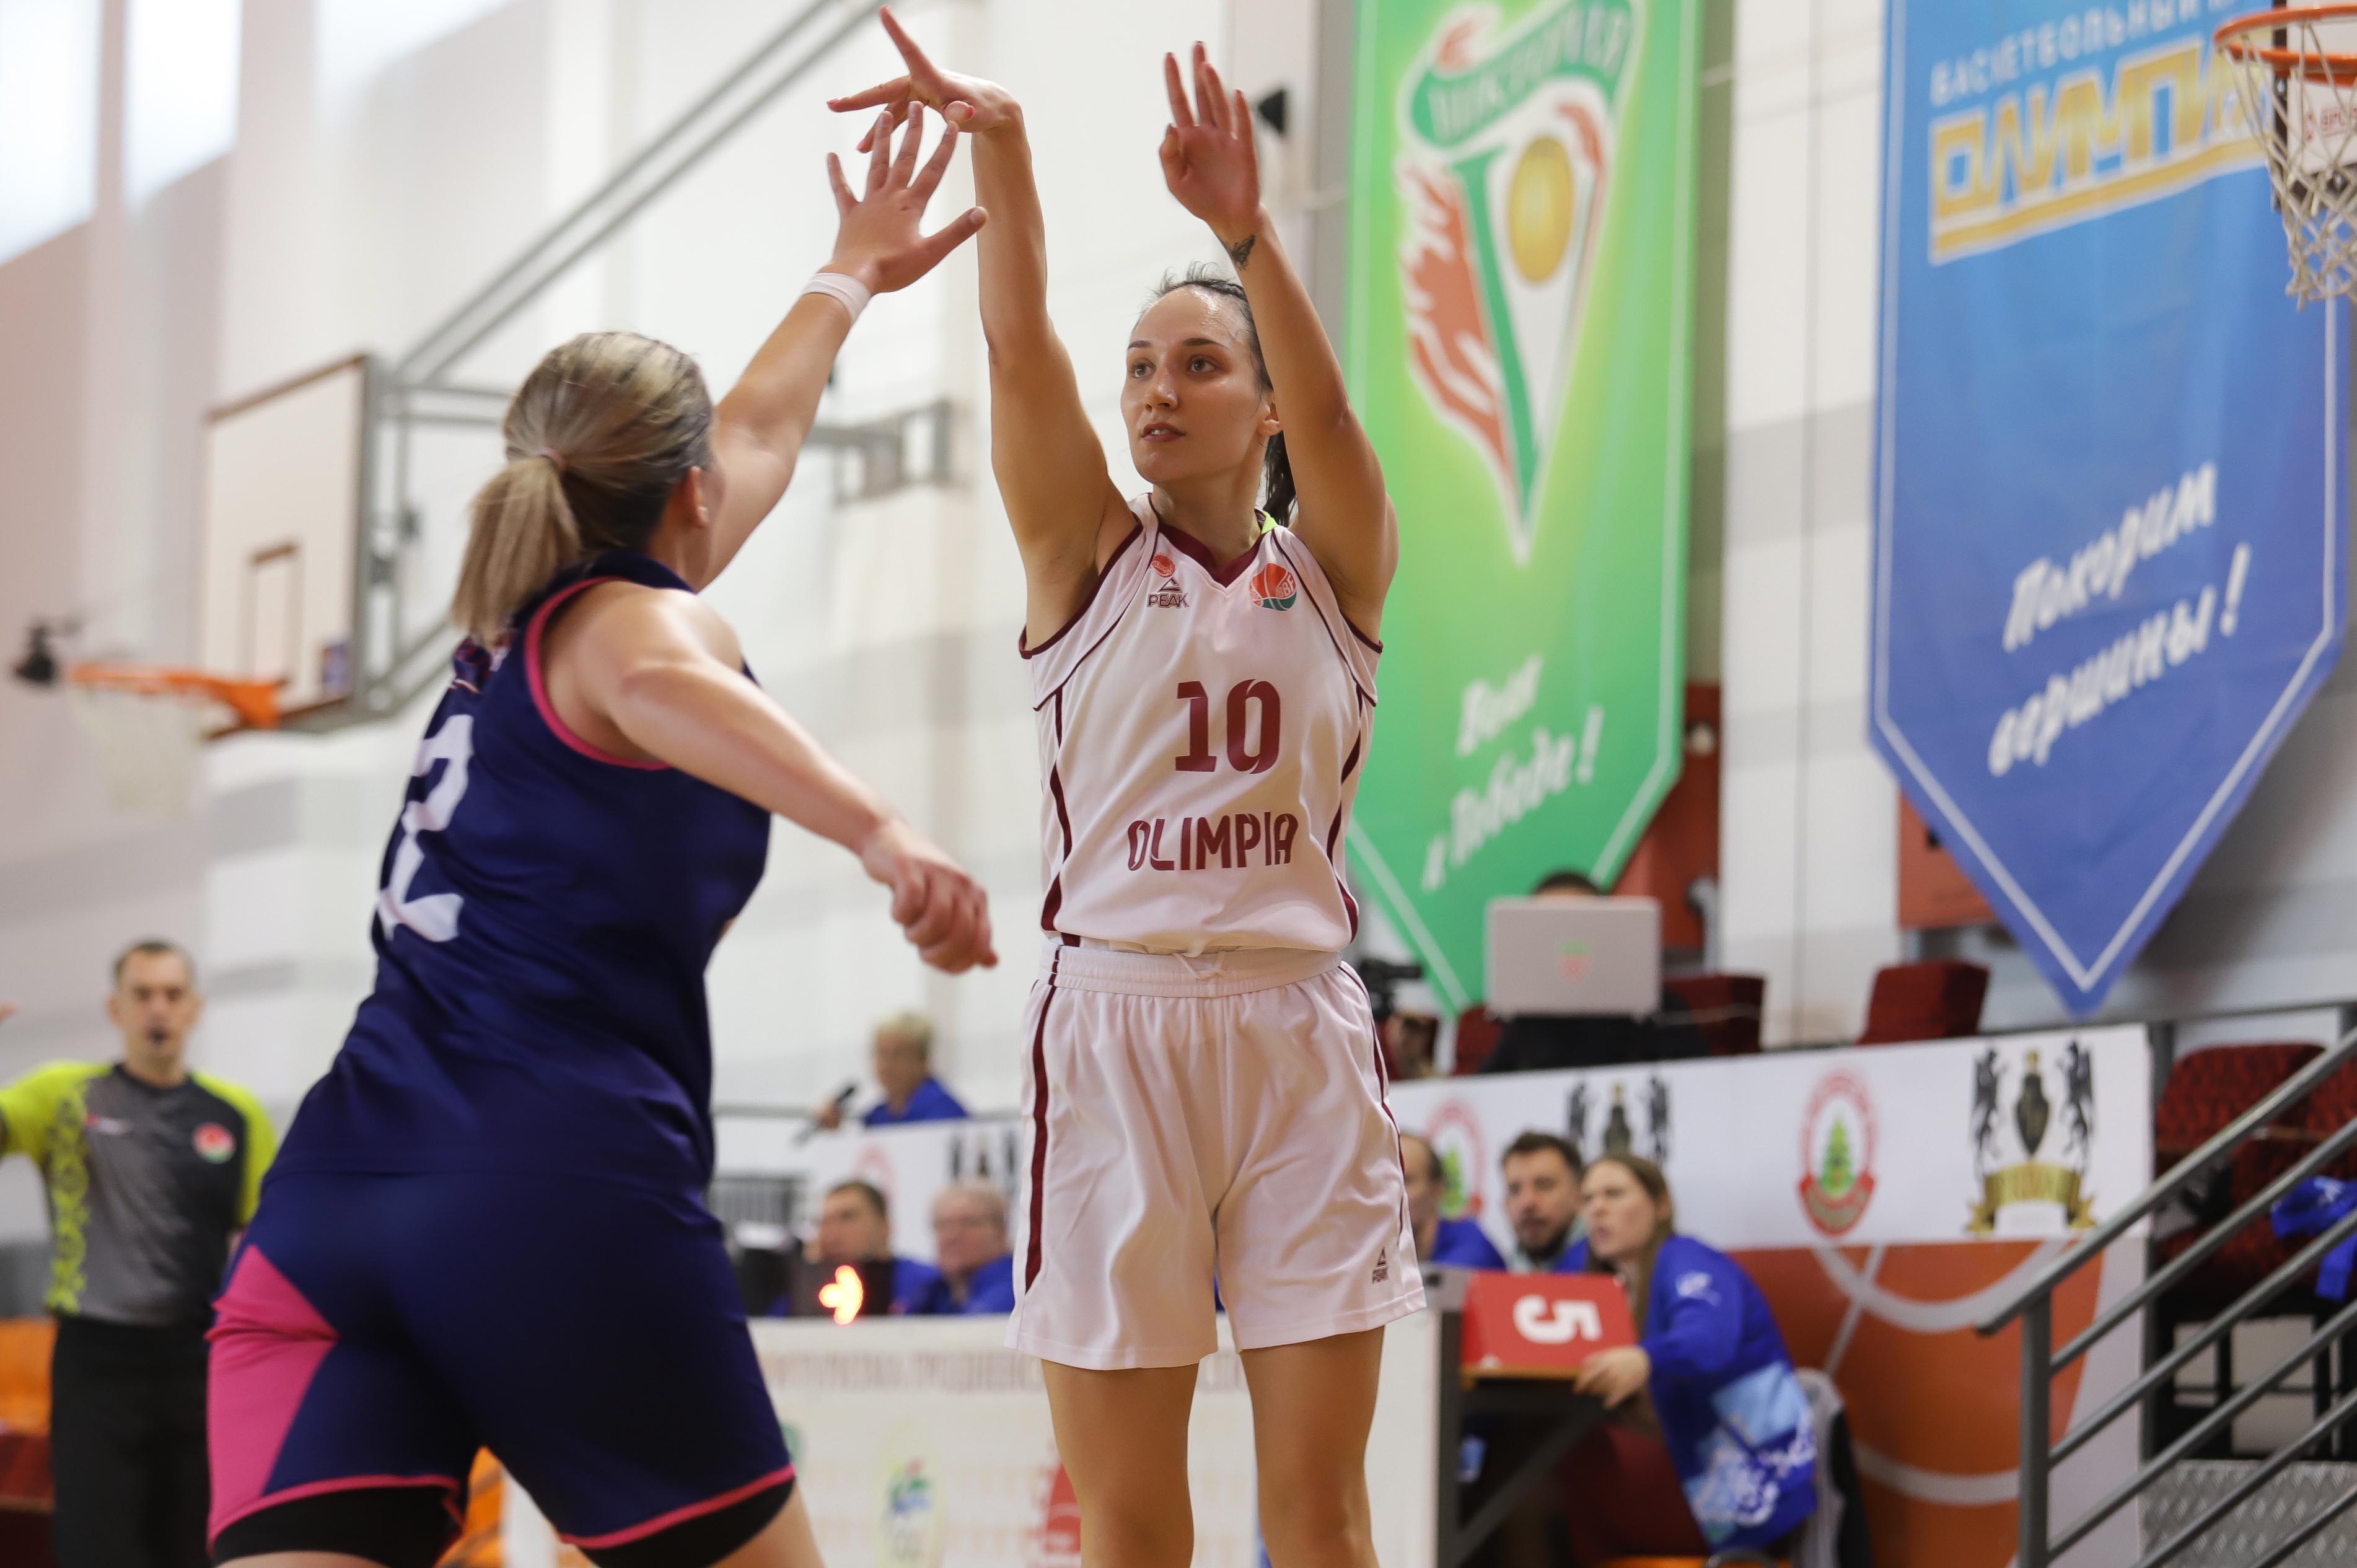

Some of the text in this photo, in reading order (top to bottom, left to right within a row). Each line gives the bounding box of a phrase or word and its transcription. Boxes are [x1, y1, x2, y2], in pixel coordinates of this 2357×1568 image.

[2003, 462, 2216, 651] Покорим
[1147, 593, 1190, 608] PEAK
[1175, 678, 1281, 774] 10
[1127, 811, 1299, 871] OLIMPIA
[1512, 1295, 1603, 1344] 5
